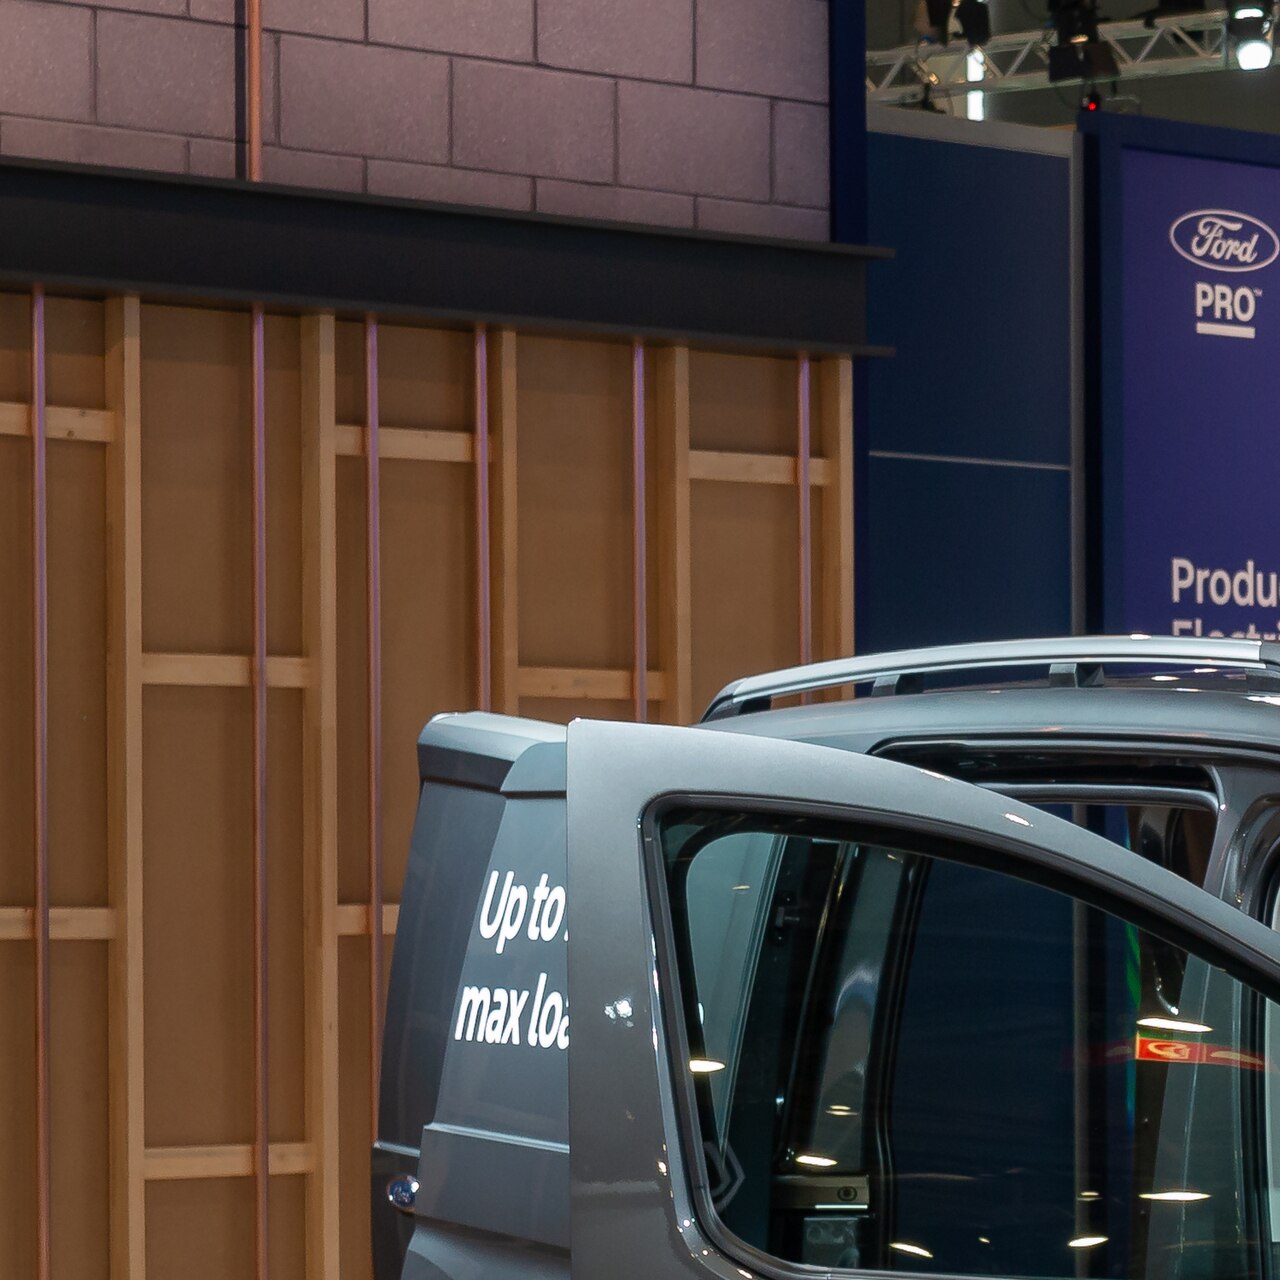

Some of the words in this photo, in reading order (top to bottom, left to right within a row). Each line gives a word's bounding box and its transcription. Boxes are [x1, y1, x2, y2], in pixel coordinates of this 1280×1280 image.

[479, 870, 528, 955] Up
[527, 872, 567, 942] to
[454, 985, 530, 1045] max
